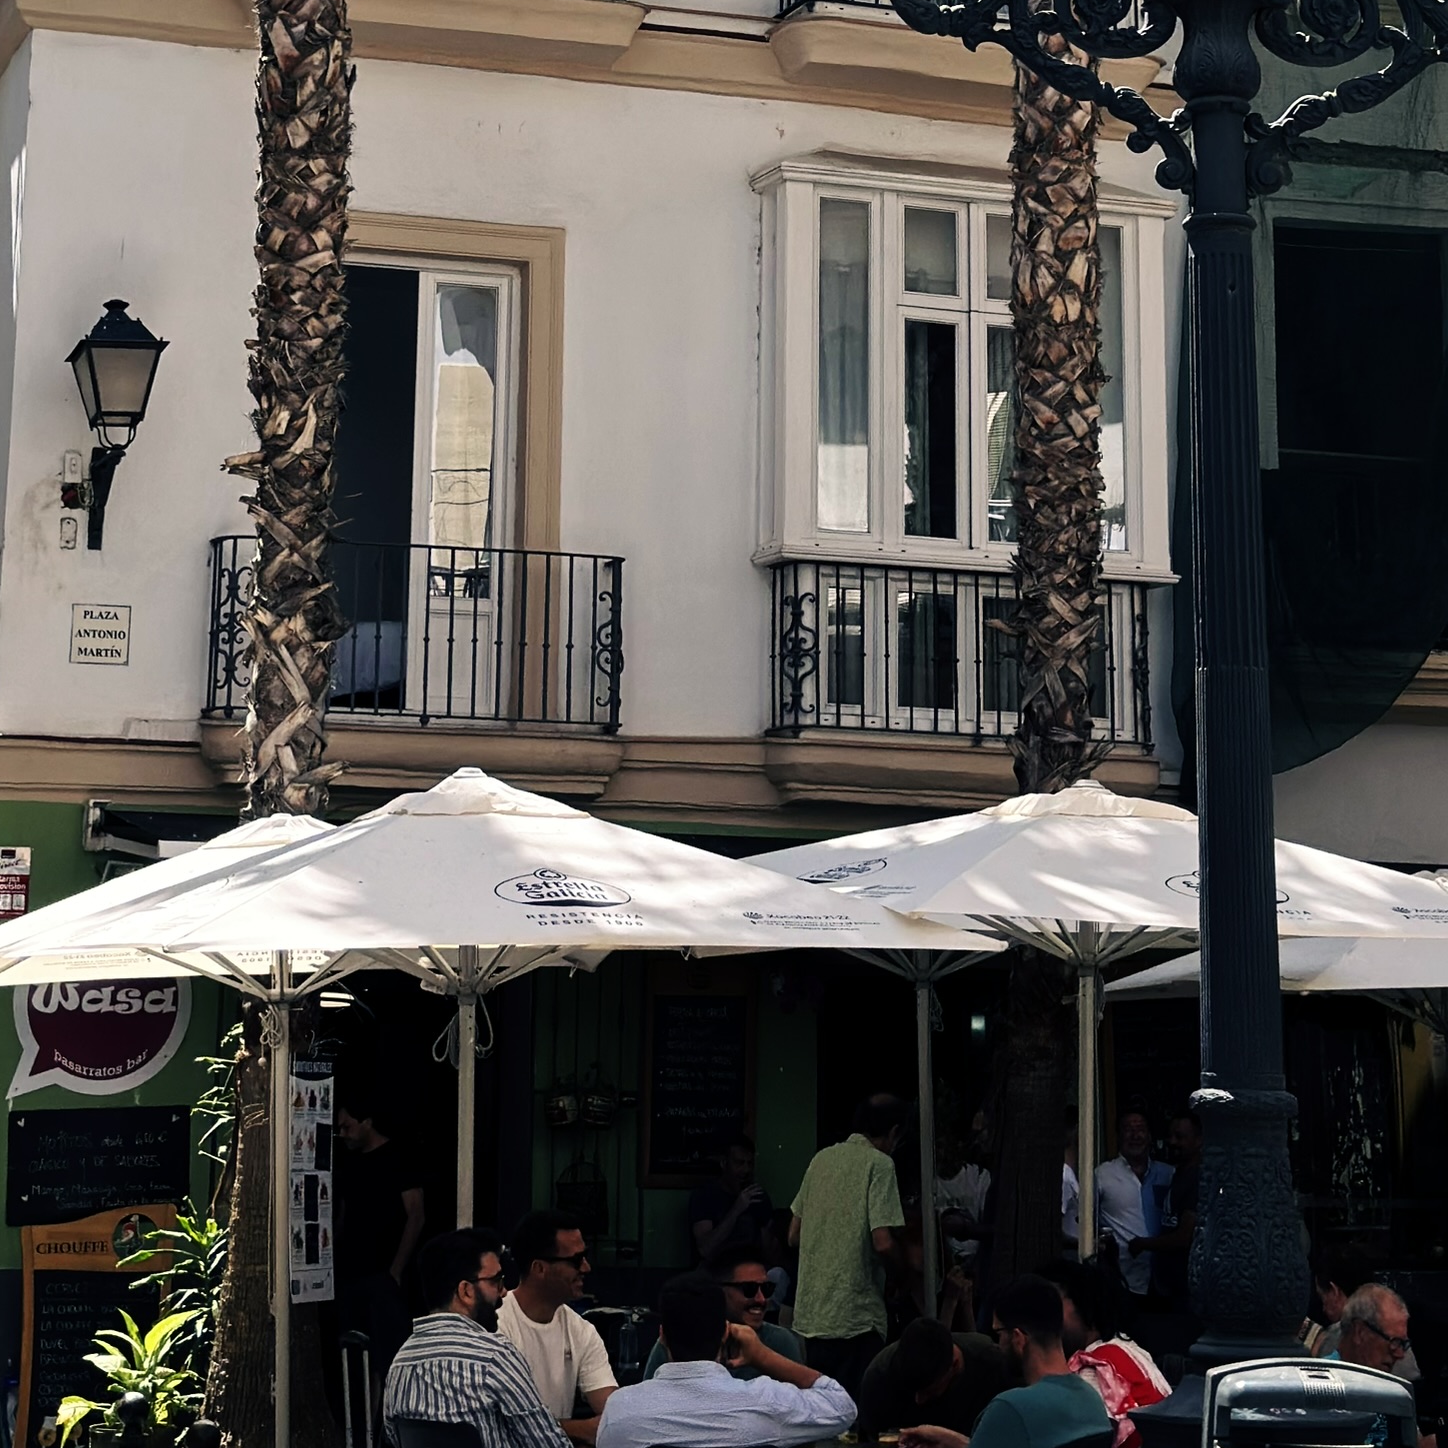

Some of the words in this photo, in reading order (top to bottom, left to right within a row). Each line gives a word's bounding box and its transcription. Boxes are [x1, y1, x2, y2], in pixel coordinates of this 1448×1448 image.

[83, 610, 119, 620] PLAZA
[75, 628, 126, 640] ANTONIO
[77, 645, 121, 658] MARTÍN
[515, 880, 605, 893] Estrella
[525, 888, 608, 900] Galicia
[526, 911, 644, 920] RESISTENCIA
[31, 982, 177, 1014] Wasa
[54, 1049, 123, 1077] pasarratos
[126, 1049, 149, 1070] bar
[36, 1240, 108, 1255] CHOUFFE
